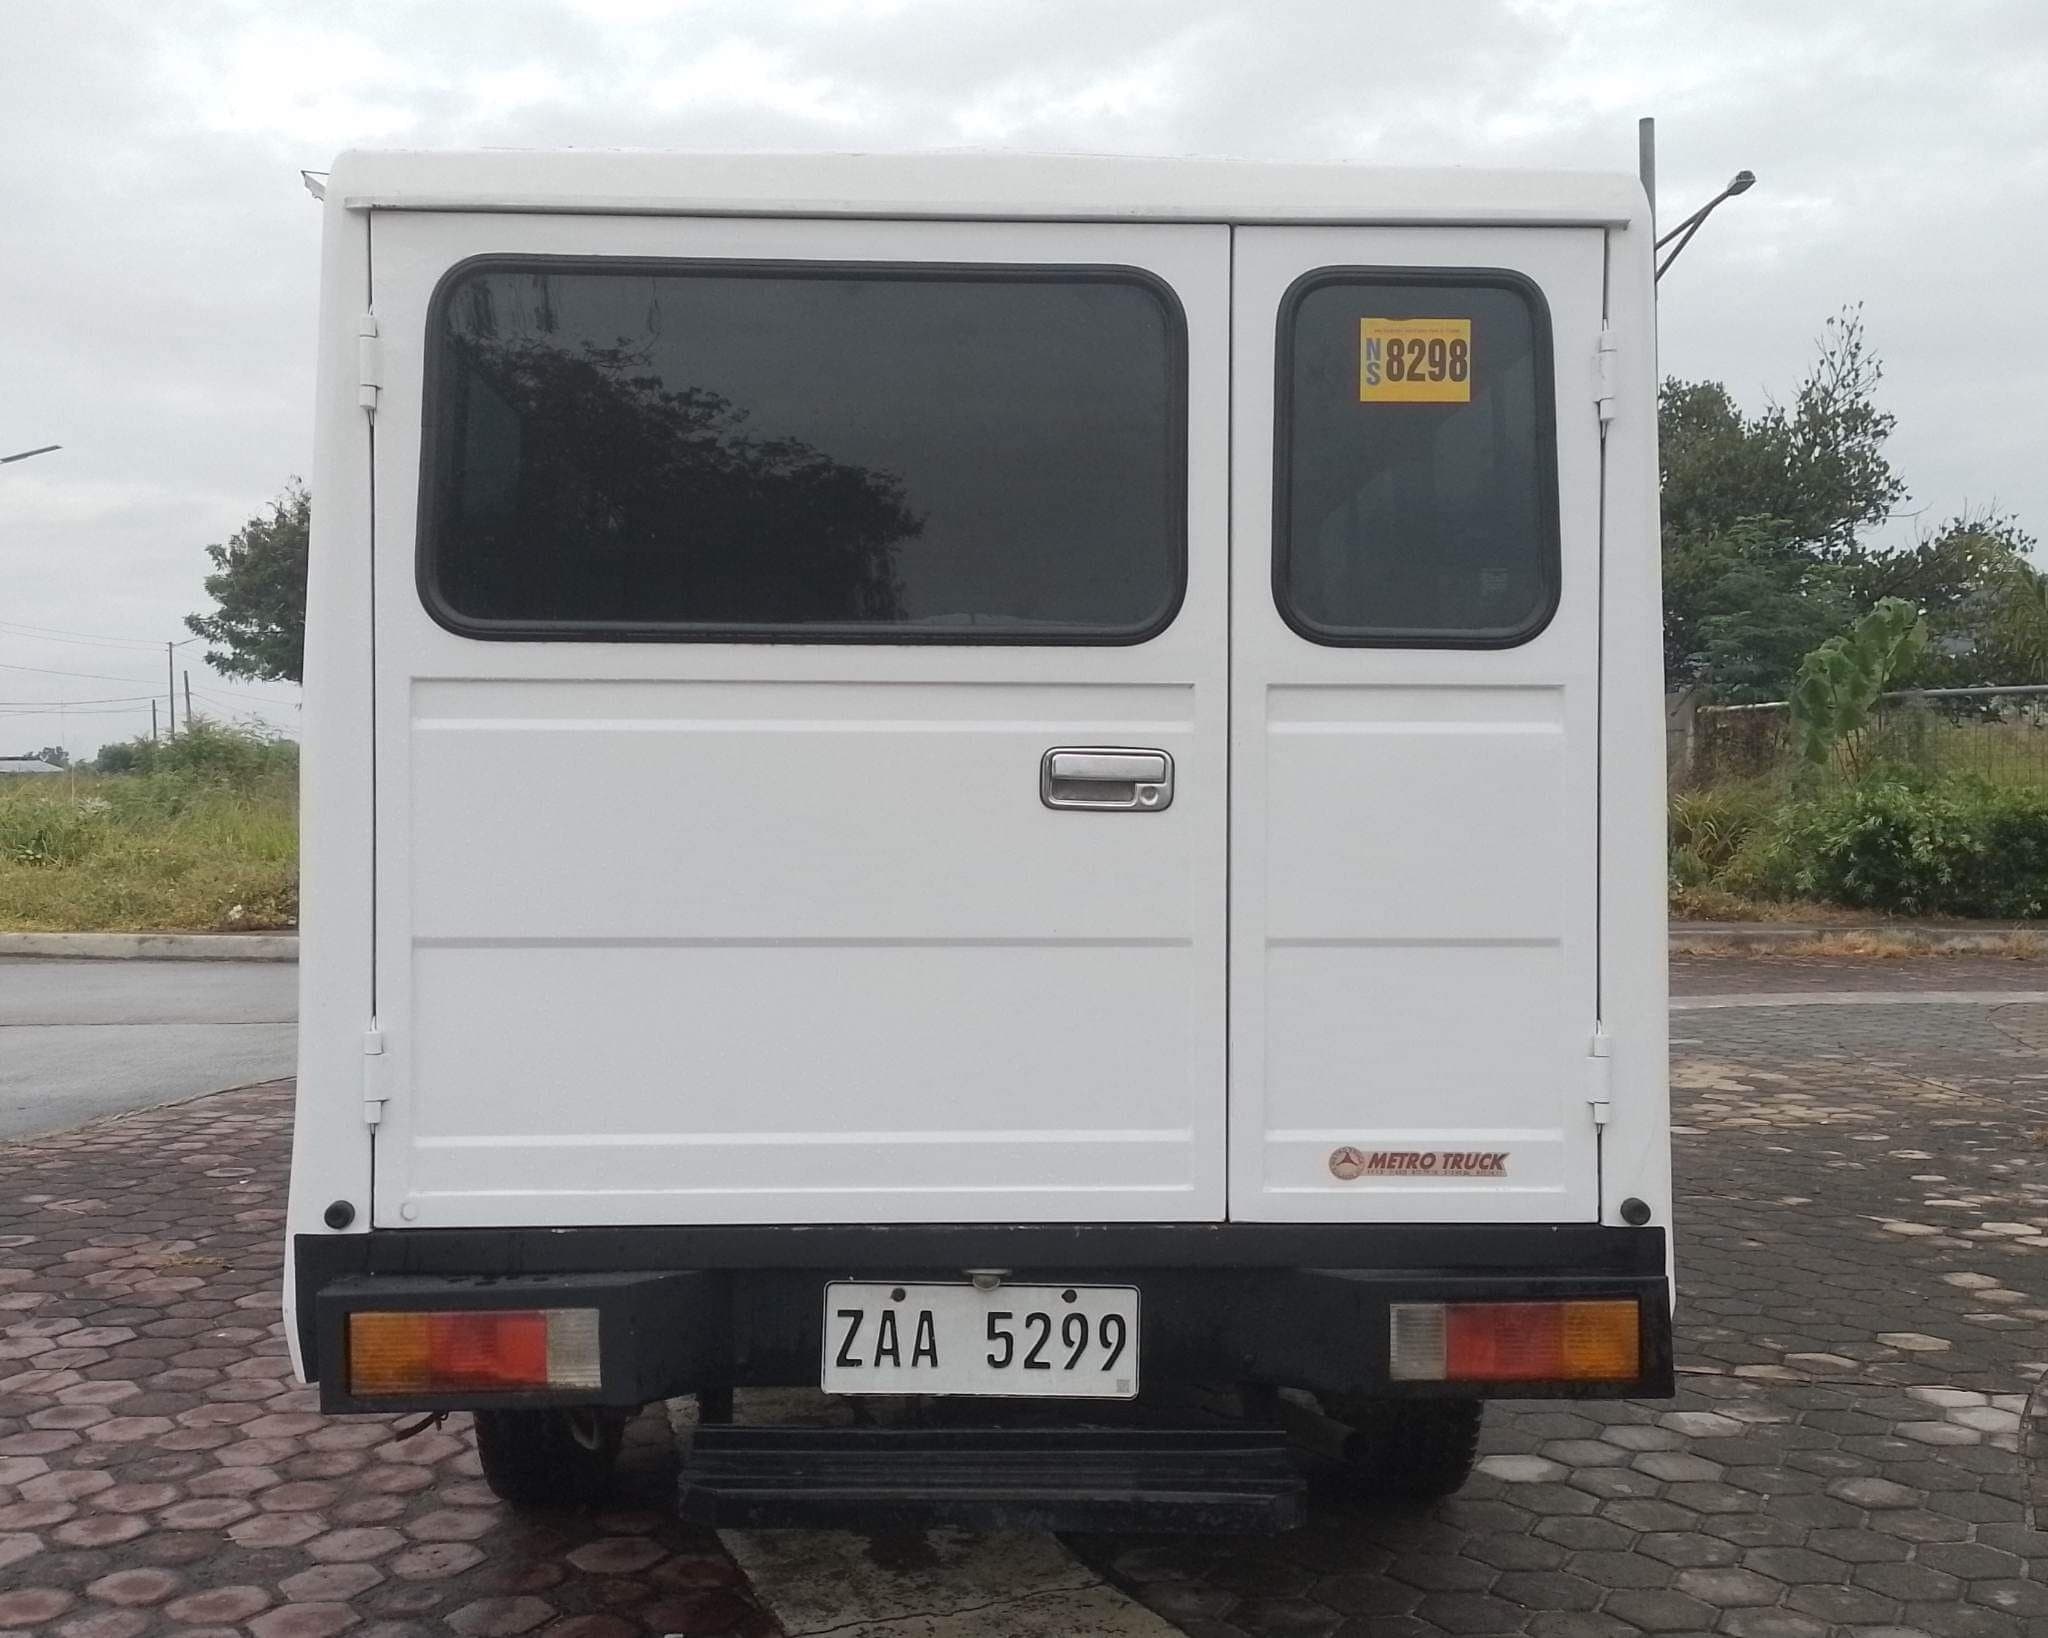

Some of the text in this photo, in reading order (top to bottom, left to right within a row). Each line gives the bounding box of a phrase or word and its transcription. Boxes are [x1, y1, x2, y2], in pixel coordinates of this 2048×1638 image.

[1386, 338, 1468, 382] 8298
[1367, 1152, 1436, 1170] METRO
[1442, 1152, 1510, 1170] TRUCK
[836, 1309, 1127, 1371] ZAA 5299
